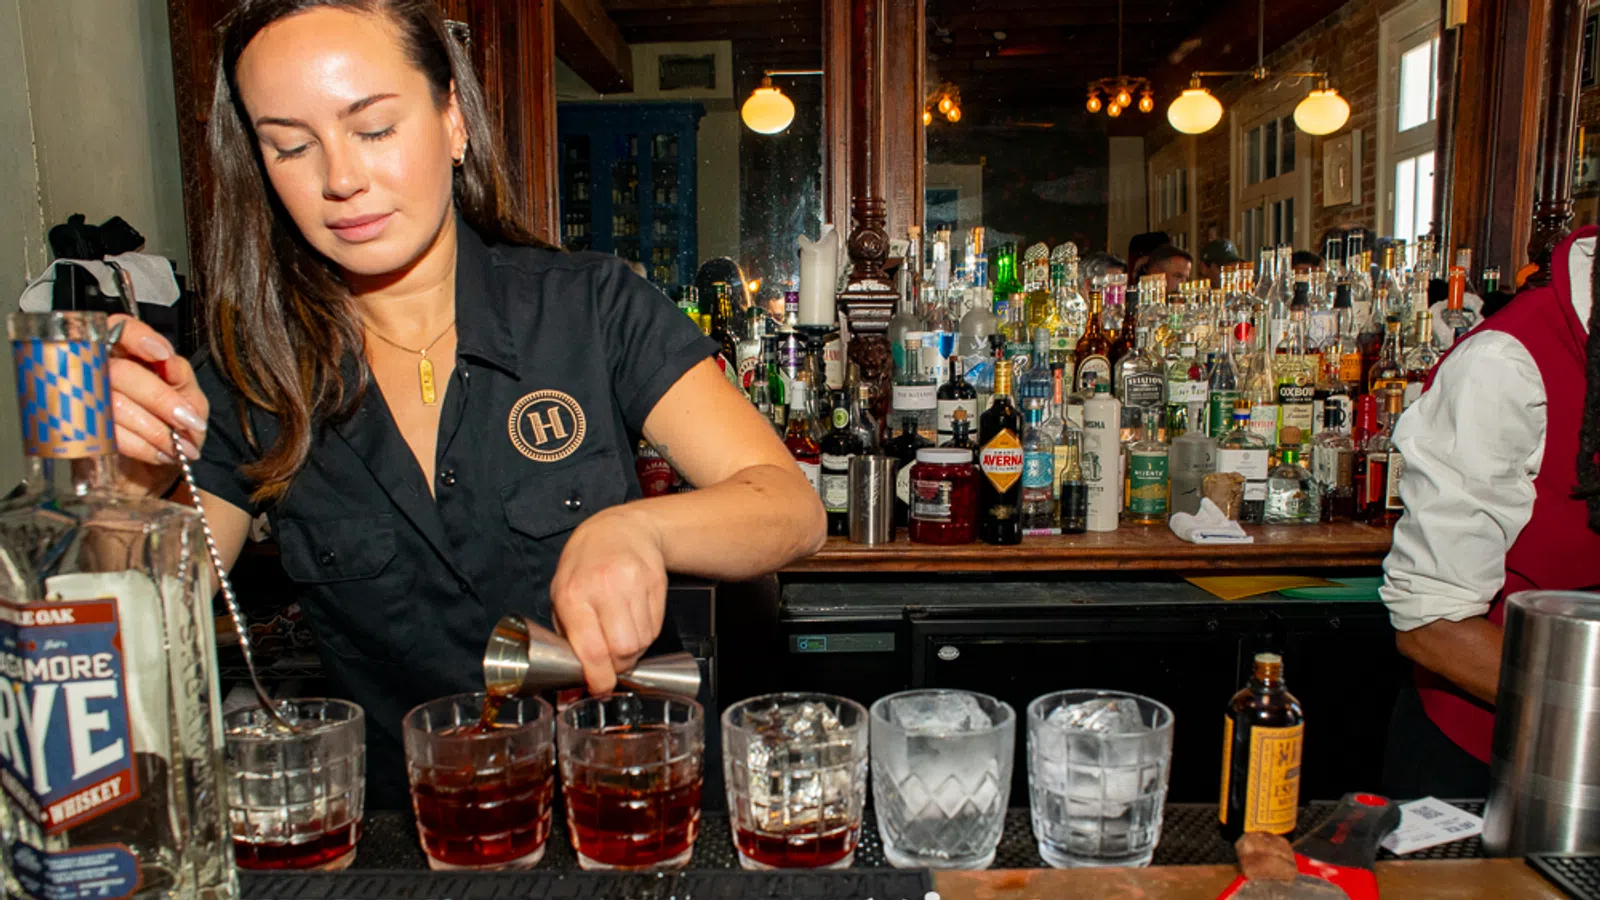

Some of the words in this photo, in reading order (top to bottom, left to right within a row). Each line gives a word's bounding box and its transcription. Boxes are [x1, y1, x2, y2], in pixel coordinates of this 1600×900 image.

[526, 406, 568, 445] H
[983, 454, 1023, 466] AVERNA
[35, 608, 76, 624] OAK
[0, 677, 124, 795] RYE
[49, 776, 122, 824] WHISKEY
